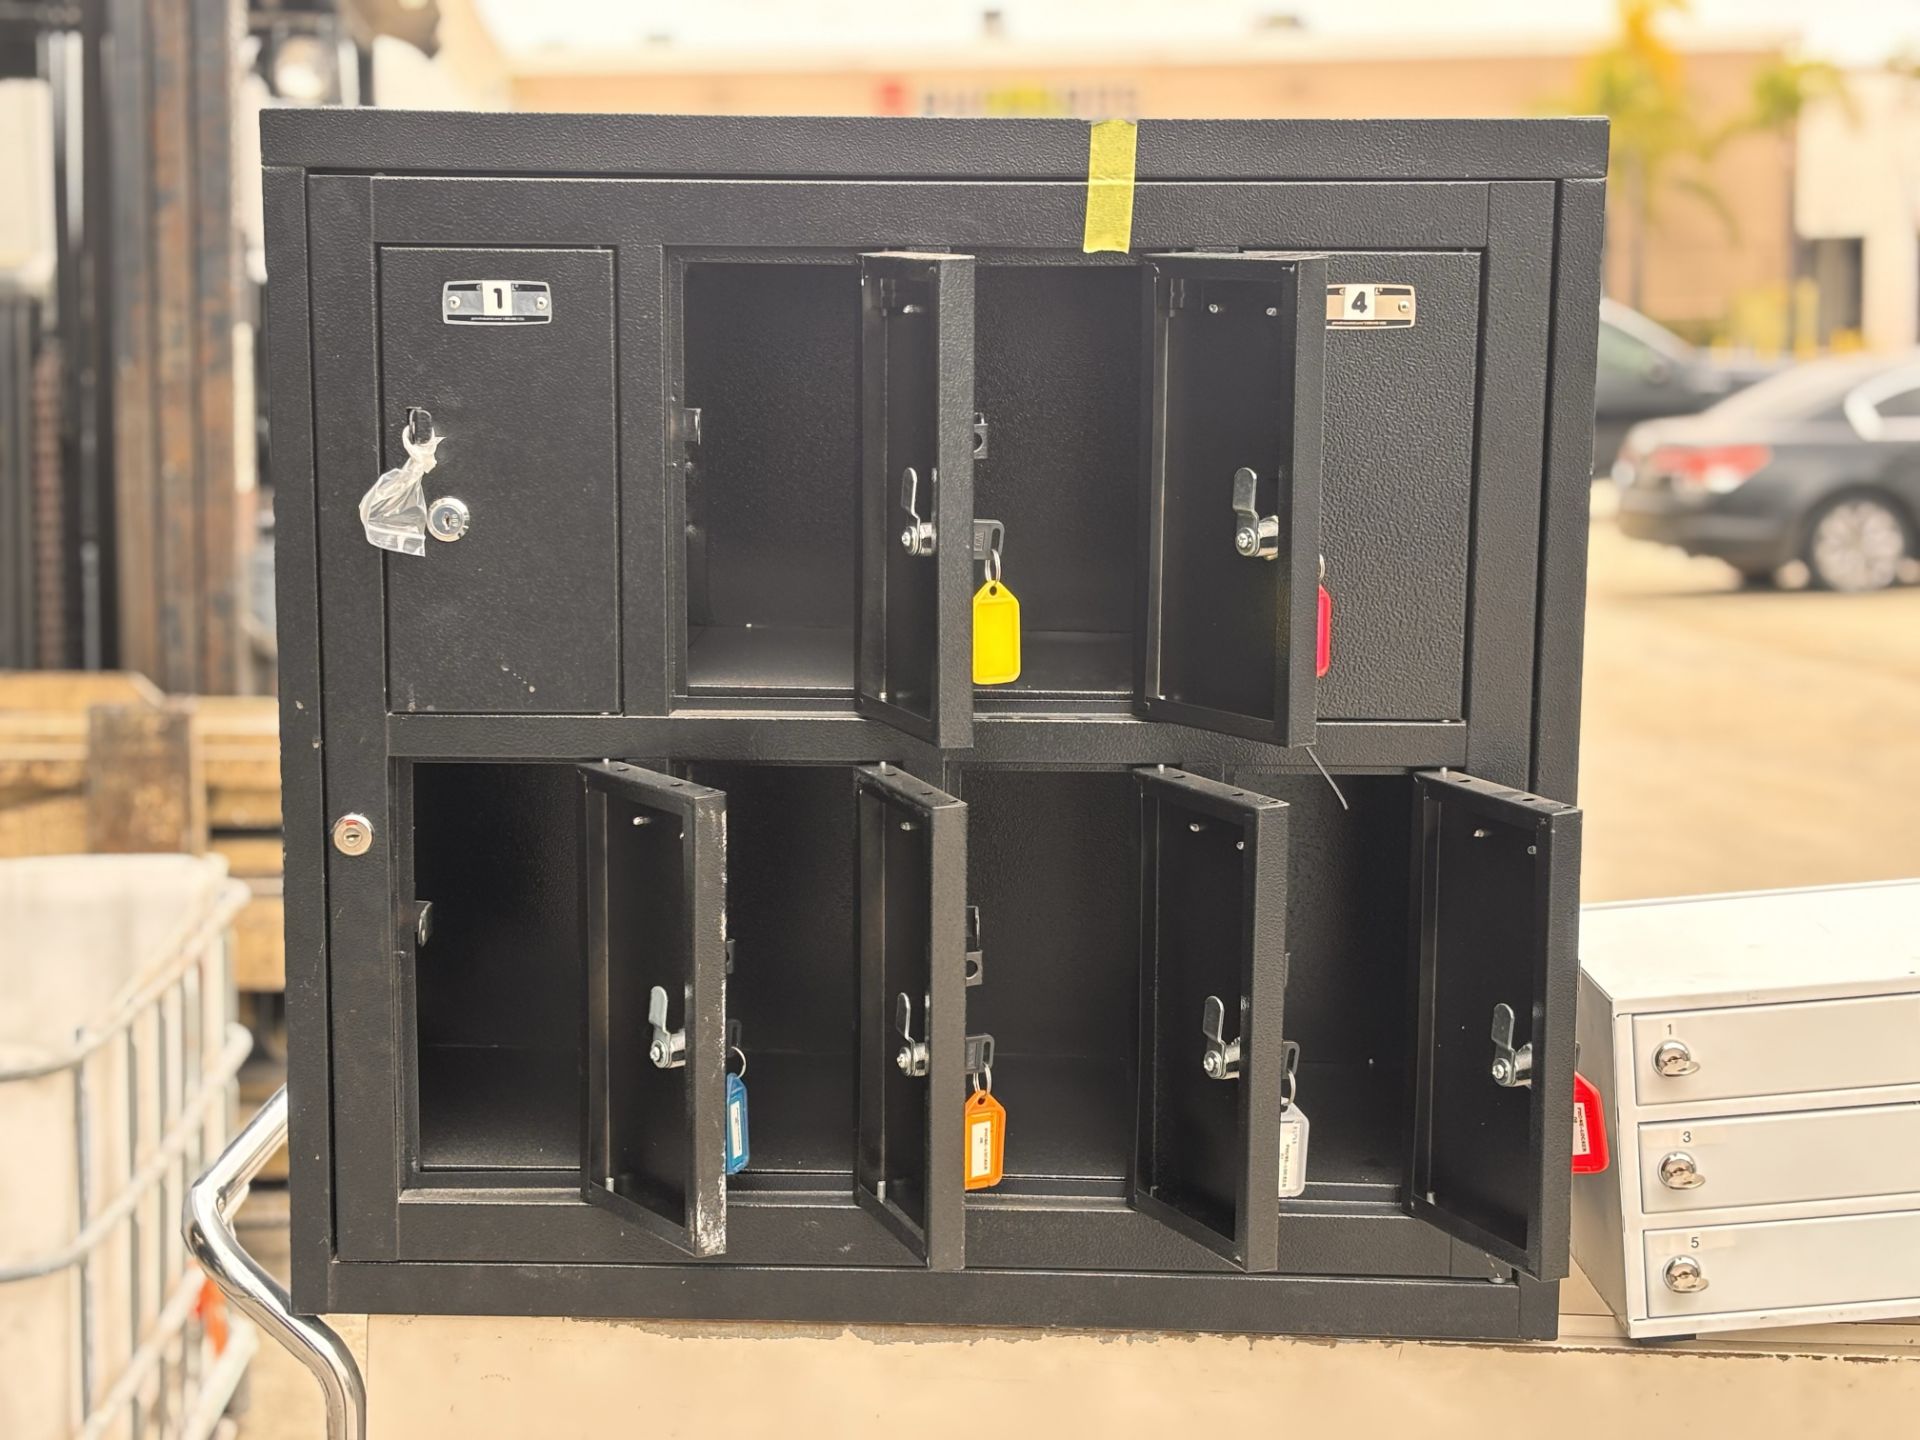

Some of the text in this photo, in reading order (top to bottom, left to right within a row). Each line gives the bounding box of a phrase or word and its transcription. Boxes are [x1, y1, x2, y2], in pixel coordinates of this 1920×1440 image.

[493, 287, 503, 309] 1
[1351, 291, 1367, 313] 4
[1667, 1024, 1673, 1035] 1
[1682, 1131, 1692, 1143] 3
[1691, 1237, 1699, 1248] 5
